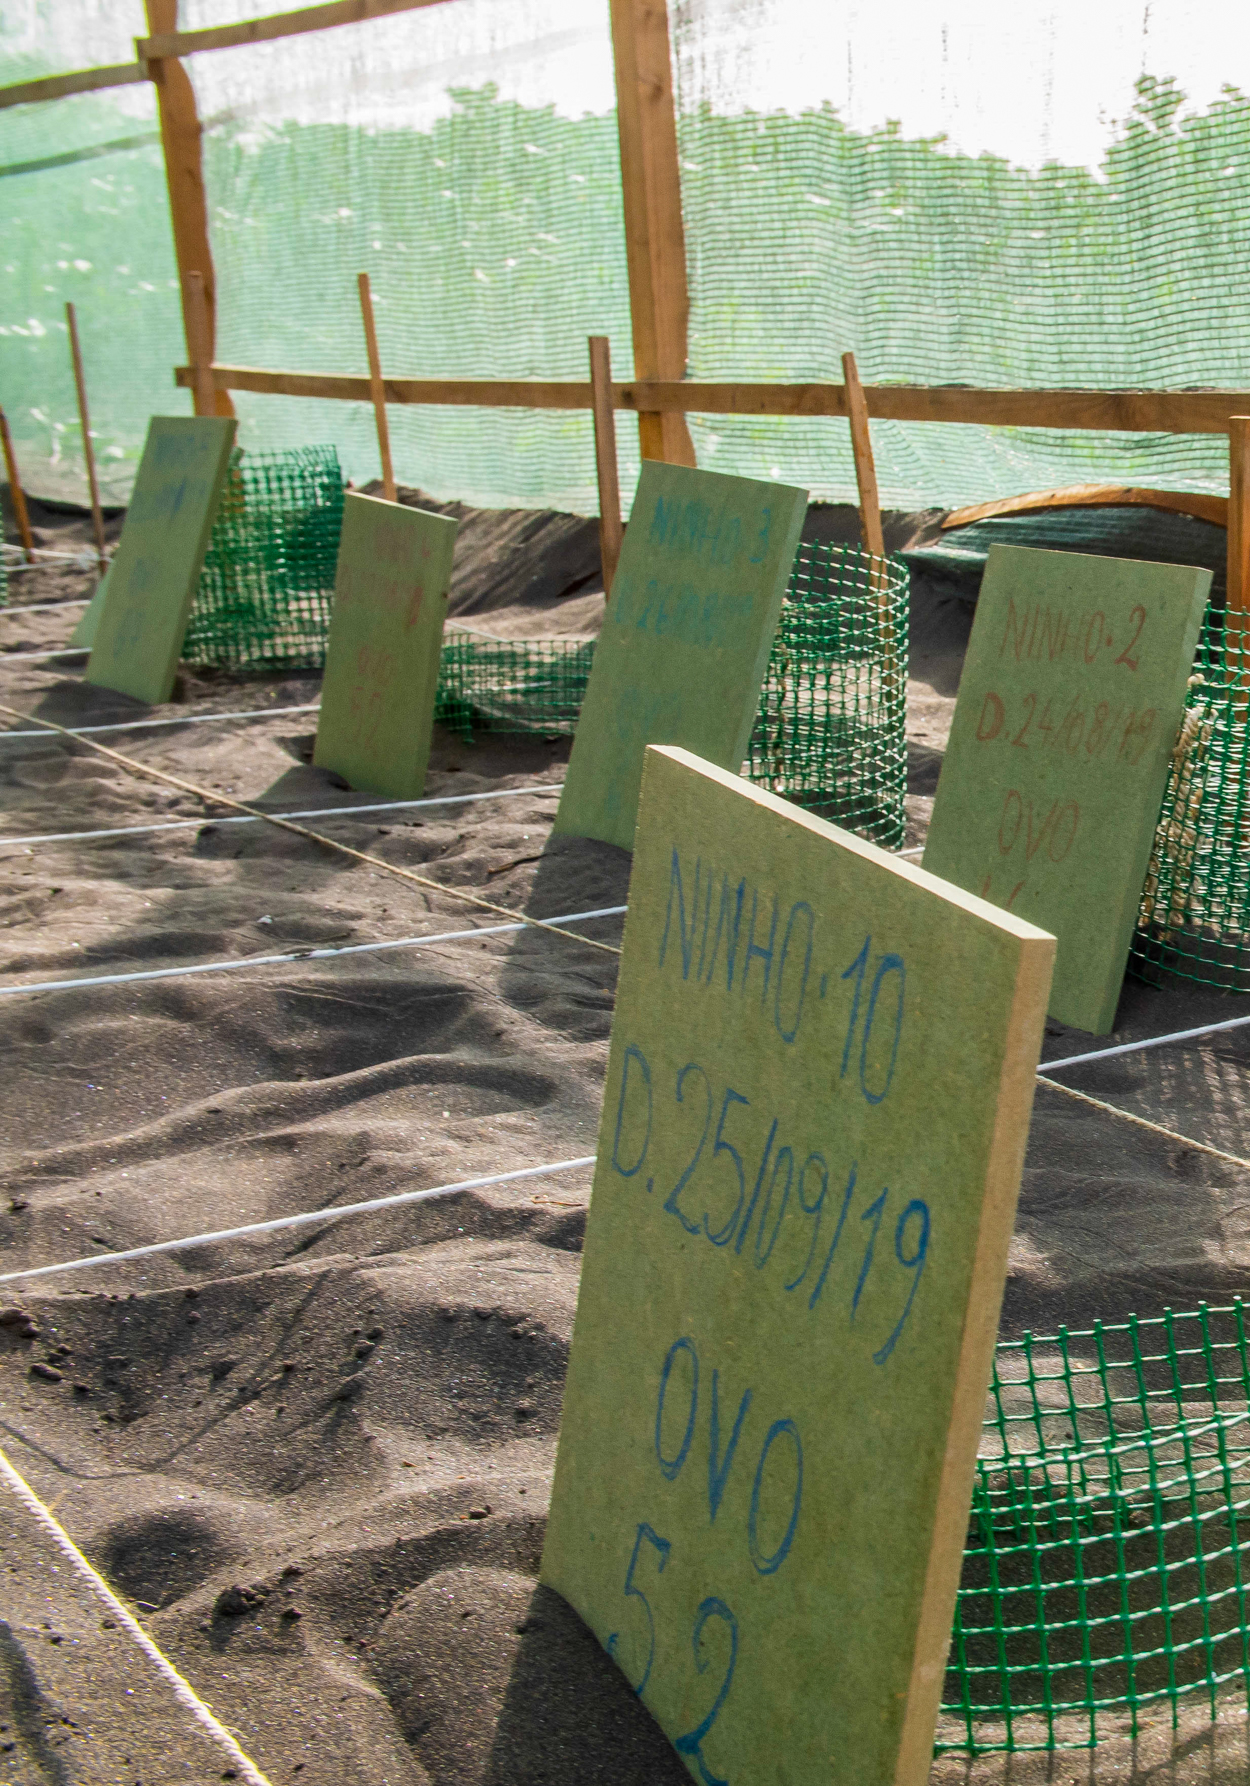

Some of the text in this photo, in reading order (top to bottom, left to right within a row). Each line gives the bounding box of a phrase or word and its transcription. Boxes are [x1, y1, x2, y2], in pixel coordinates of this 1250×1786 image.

[998, 788, 1081, 863] OVO
[654, 1336, 804, 1575] OVO
[605, 1522, 737, 1786] 52
